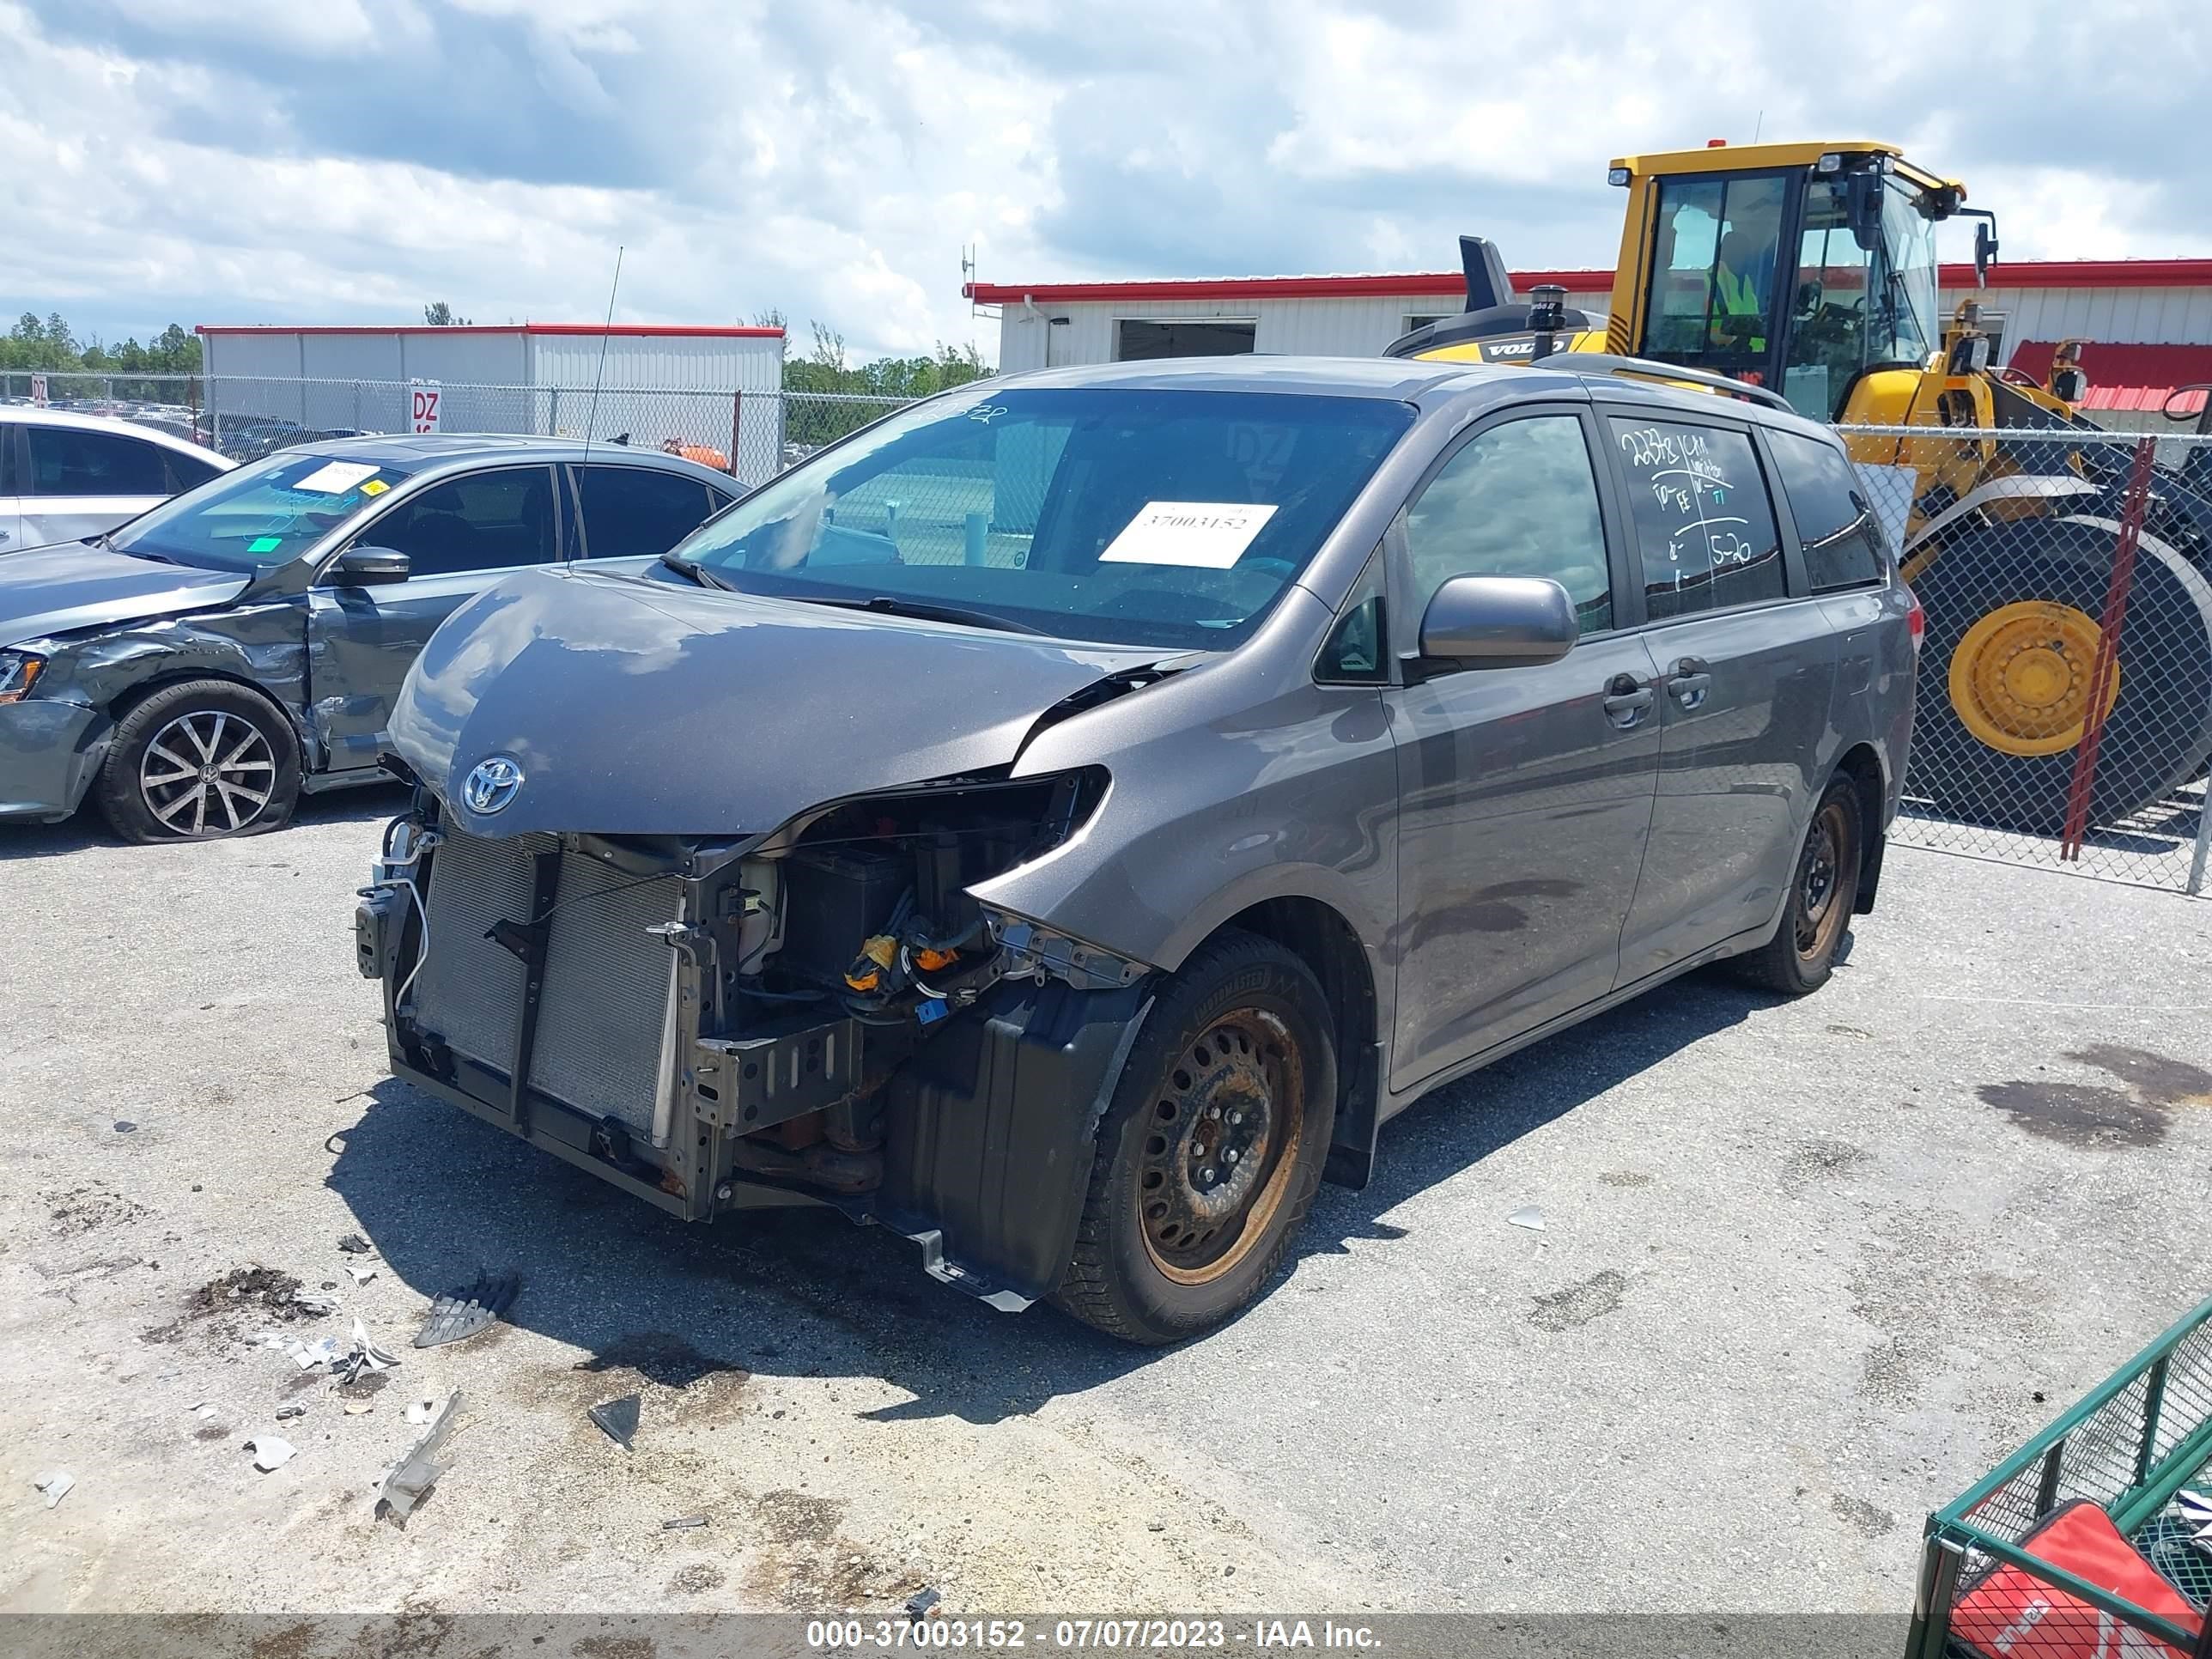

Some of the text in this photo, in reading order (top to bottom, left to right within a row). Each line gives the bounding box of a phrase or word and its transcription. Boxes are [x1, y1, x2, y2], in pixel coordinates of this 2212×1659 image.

[1488, 341, 1565, 356] VOLO
[34, 380, 46, 401] DZ
[414, 392, 439, 422] DZ
[1143, 515, 1248, 529] 37003152
